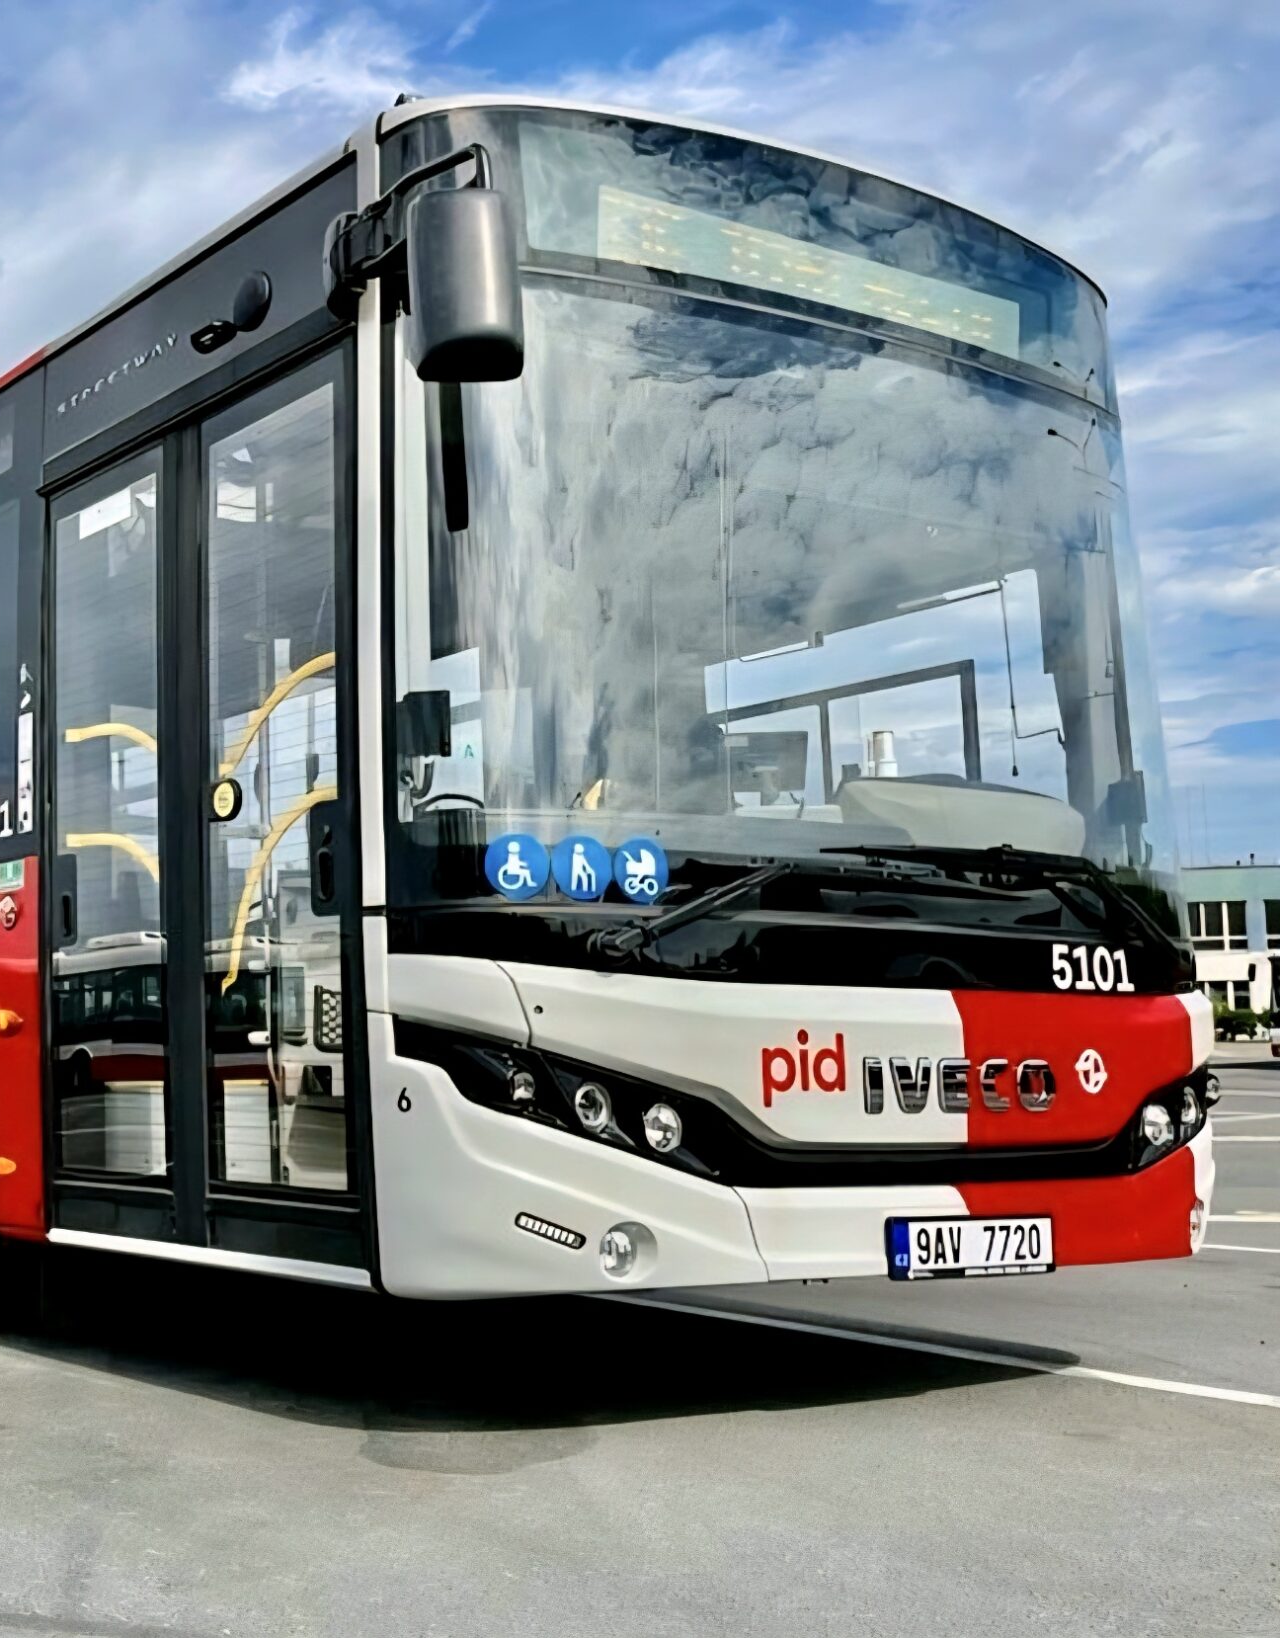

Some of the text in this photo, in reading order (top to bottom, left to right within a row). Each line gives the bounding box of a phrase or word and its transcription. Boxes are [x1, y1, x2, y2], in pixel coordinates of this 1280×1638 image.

[1052, 943, 1135, 992] 5101
[762, 1029, 1057, 1114] pid IVECO
[397, 1086, 412, 1113] 6
[916, 1223, 1041, 1265] 9AV 7720
